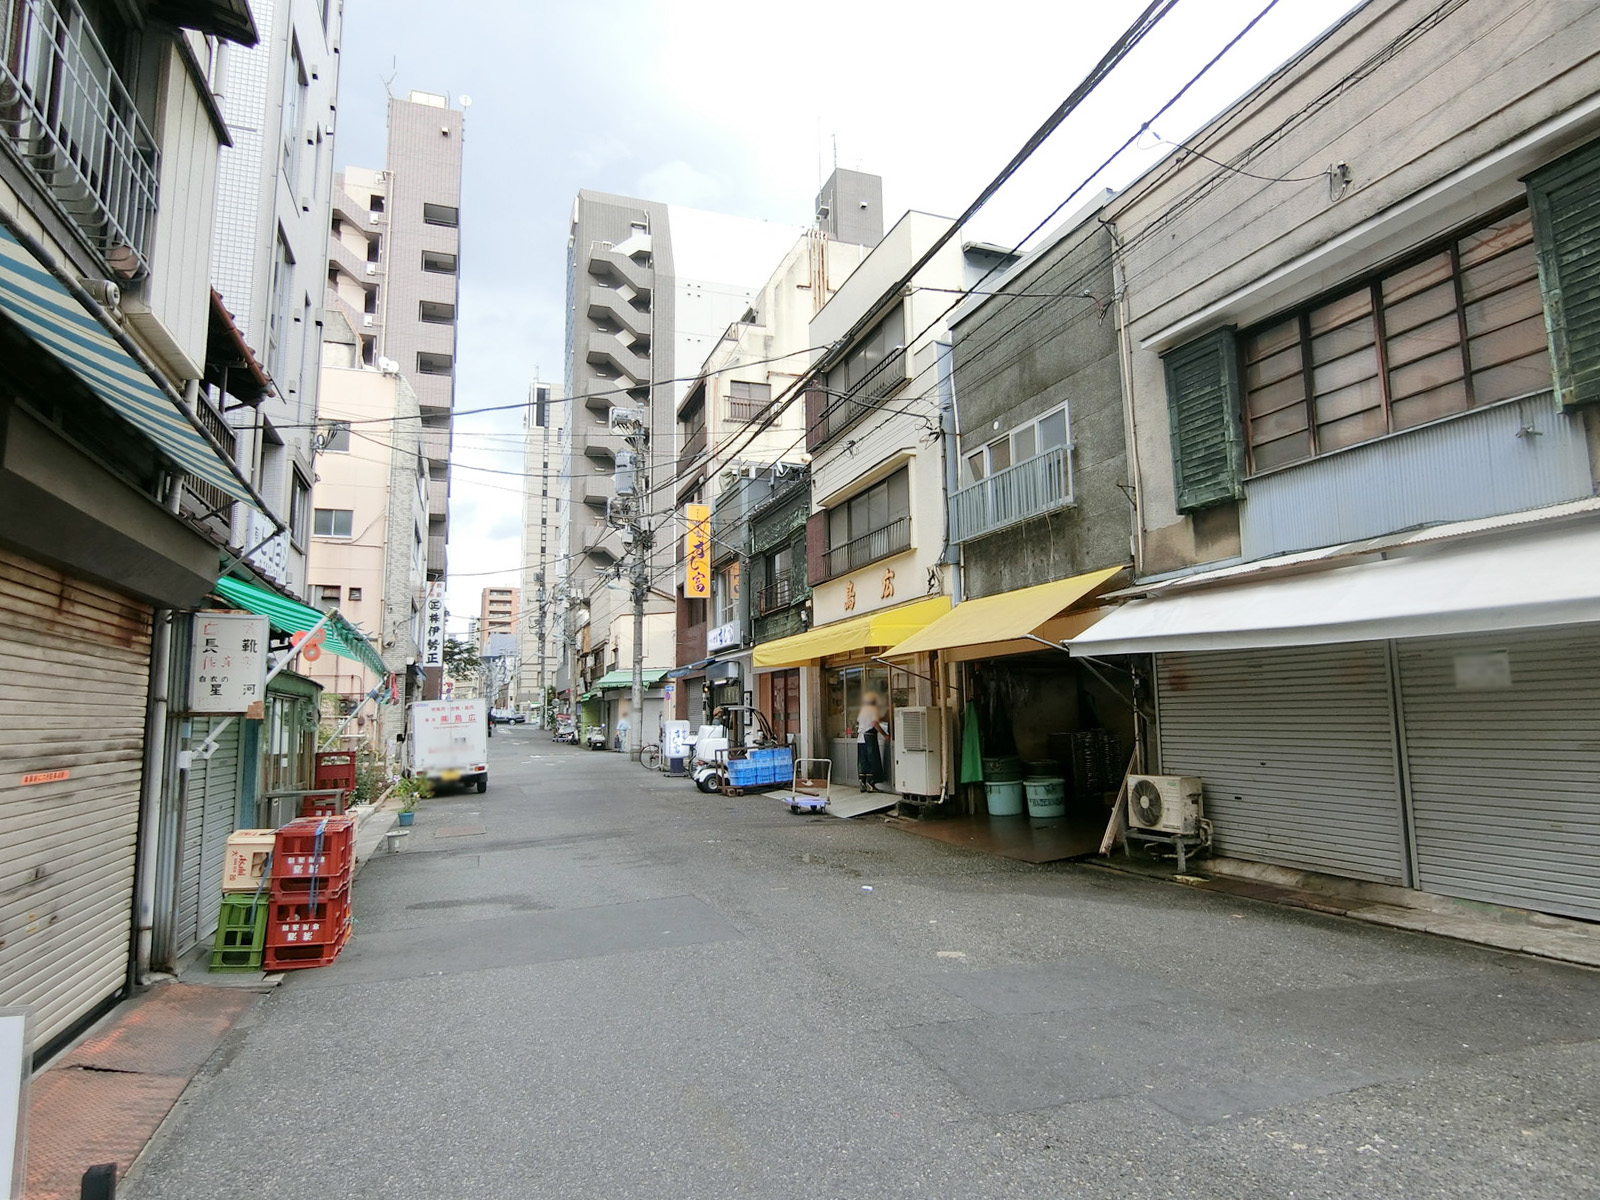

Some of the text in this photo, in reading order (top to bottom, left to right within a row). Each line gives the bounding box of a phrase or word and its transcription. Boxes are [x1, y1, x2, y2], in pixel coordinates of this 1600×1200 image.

[203, 638, 258, 654] 長靴
[199, 675, 229, 683] 白衣の
[210, 683, 256, 697] 星河
[286, 931, 313, 942] 清酒
